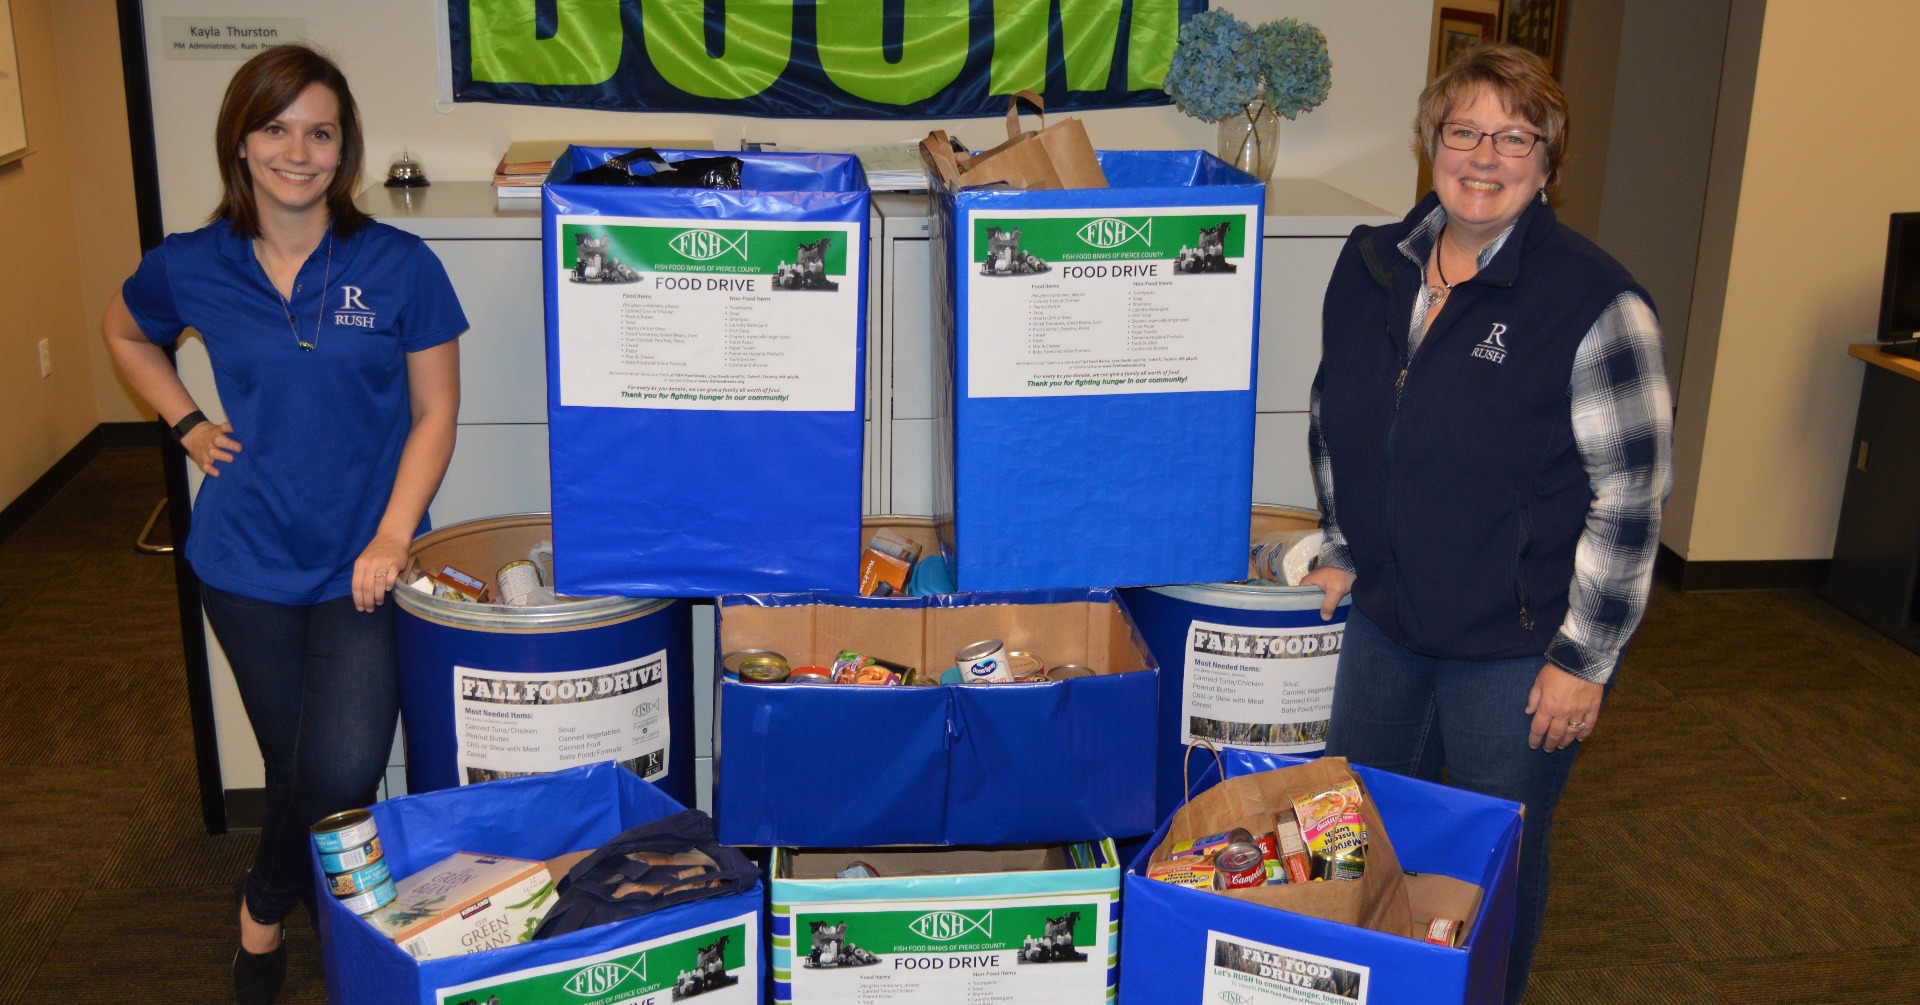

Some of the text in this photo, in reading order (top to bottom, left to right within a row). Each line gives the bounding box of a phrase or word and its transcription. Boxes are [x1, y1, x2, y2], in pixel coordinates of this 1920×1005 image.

[190, 27, 277, 38] Kayla Thurston
[1087, 220, 1126, 245] FISH
[680, 232, 721, 258] FISH
[1064, 265, 1157, 278] FOOD DRIVE
[656, 278, 755, 291] FOOD DRIVE
[341, 286, 370, 310] R
[335, 315, 375, 328] RUSH
[1483, 323, 1507, 347] R
[1470, 347, 1505, 364] RUSH
[670, 393, 697, 401] fighting
[1195, 632, 1250, 653] FALL
[1255, 638, 1318, 654] FOOD
[1194, 659, 1211, 667] Most
[1213, 662, 1238, 671] Needed
[463, 664, 662, 700] FALL FOOD DRIVE
[1193, 674, 1217, 682] Canned
[1192, 683, 1215, 691] Peanut
[465, 707, 482, 715] Most
[484, 709, 509, 718] Needed
[635, 702, 652, 716] FISH
[465, 723, 537, 734] Canned Tuna/Chicken
[558, 728, 621, 742] Canned Vegetables
[466, 732, 488, 740] Peanut
[467, 751, 487, 759] Cereal
[559, 744, 584, 752] Canned
[560, 746, 622, 762] Baby Food/Formula
[649, 752, 659, 766] R
[461, 899, 489, 915] KIRKLAND
[476, 917, 487, 927] CUT
[921, 914, 964, 939] FISH
[462, 915, 509, 946] GREEN
[894, 955, 999, 970] FOOD DRIVE
[1242, 948, 1331, 978] FALL FOOD
[575, 966, 620, 994] FISH
[1214, 968, 1231, 977] Let's
[1233, 973, 1254, 983] RUSH
[1264, 981, 1291, 992] combat
[1259, 964, 1312, 988] DRIVE
[615, 990, 635, 1002] PIERCE
[637, 983, 660, 994] COUNTY
[1222, 991, 1240, 1004] FISH
